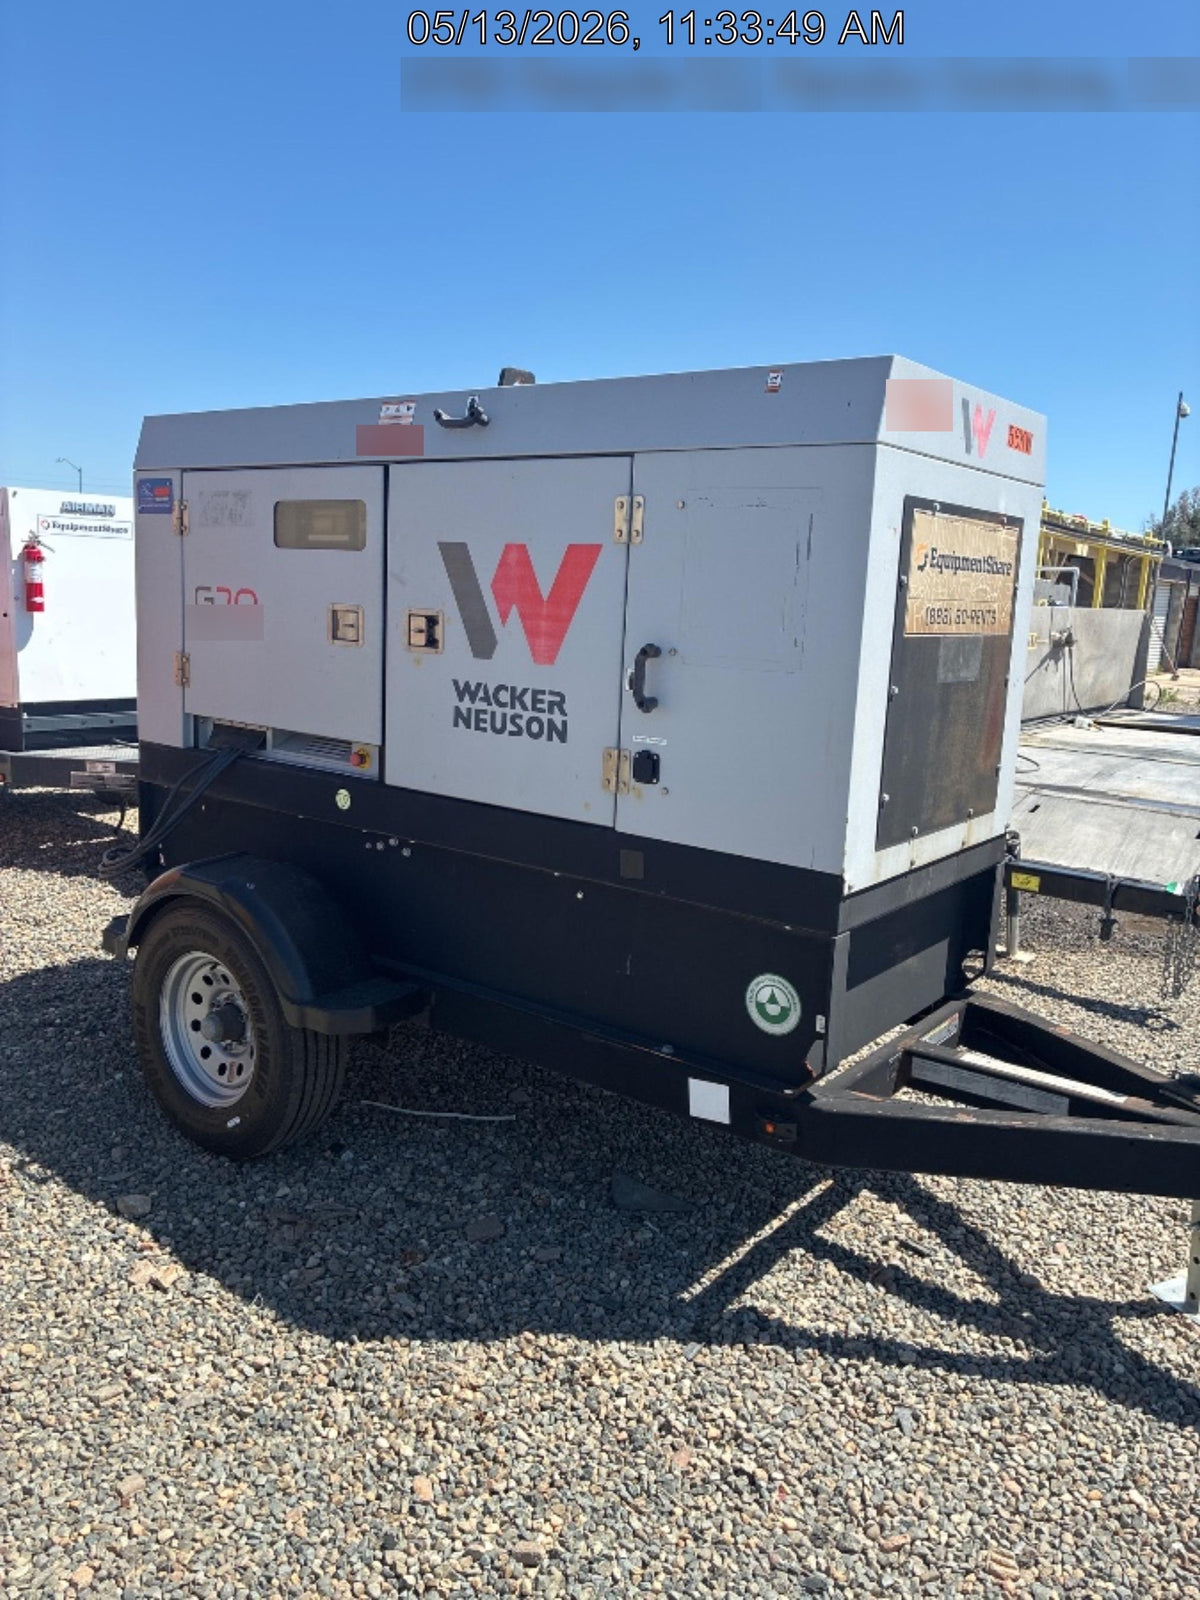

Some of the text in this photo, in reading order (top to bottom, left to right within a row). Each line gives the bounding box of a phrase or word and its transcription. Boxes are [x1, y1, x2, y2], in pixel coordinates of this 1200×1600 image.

[930, 547, 1013, 577] EquipmentShare
[451, 678, 568, 717] WACKER
[452, 705, 568, 744] NEUSON
